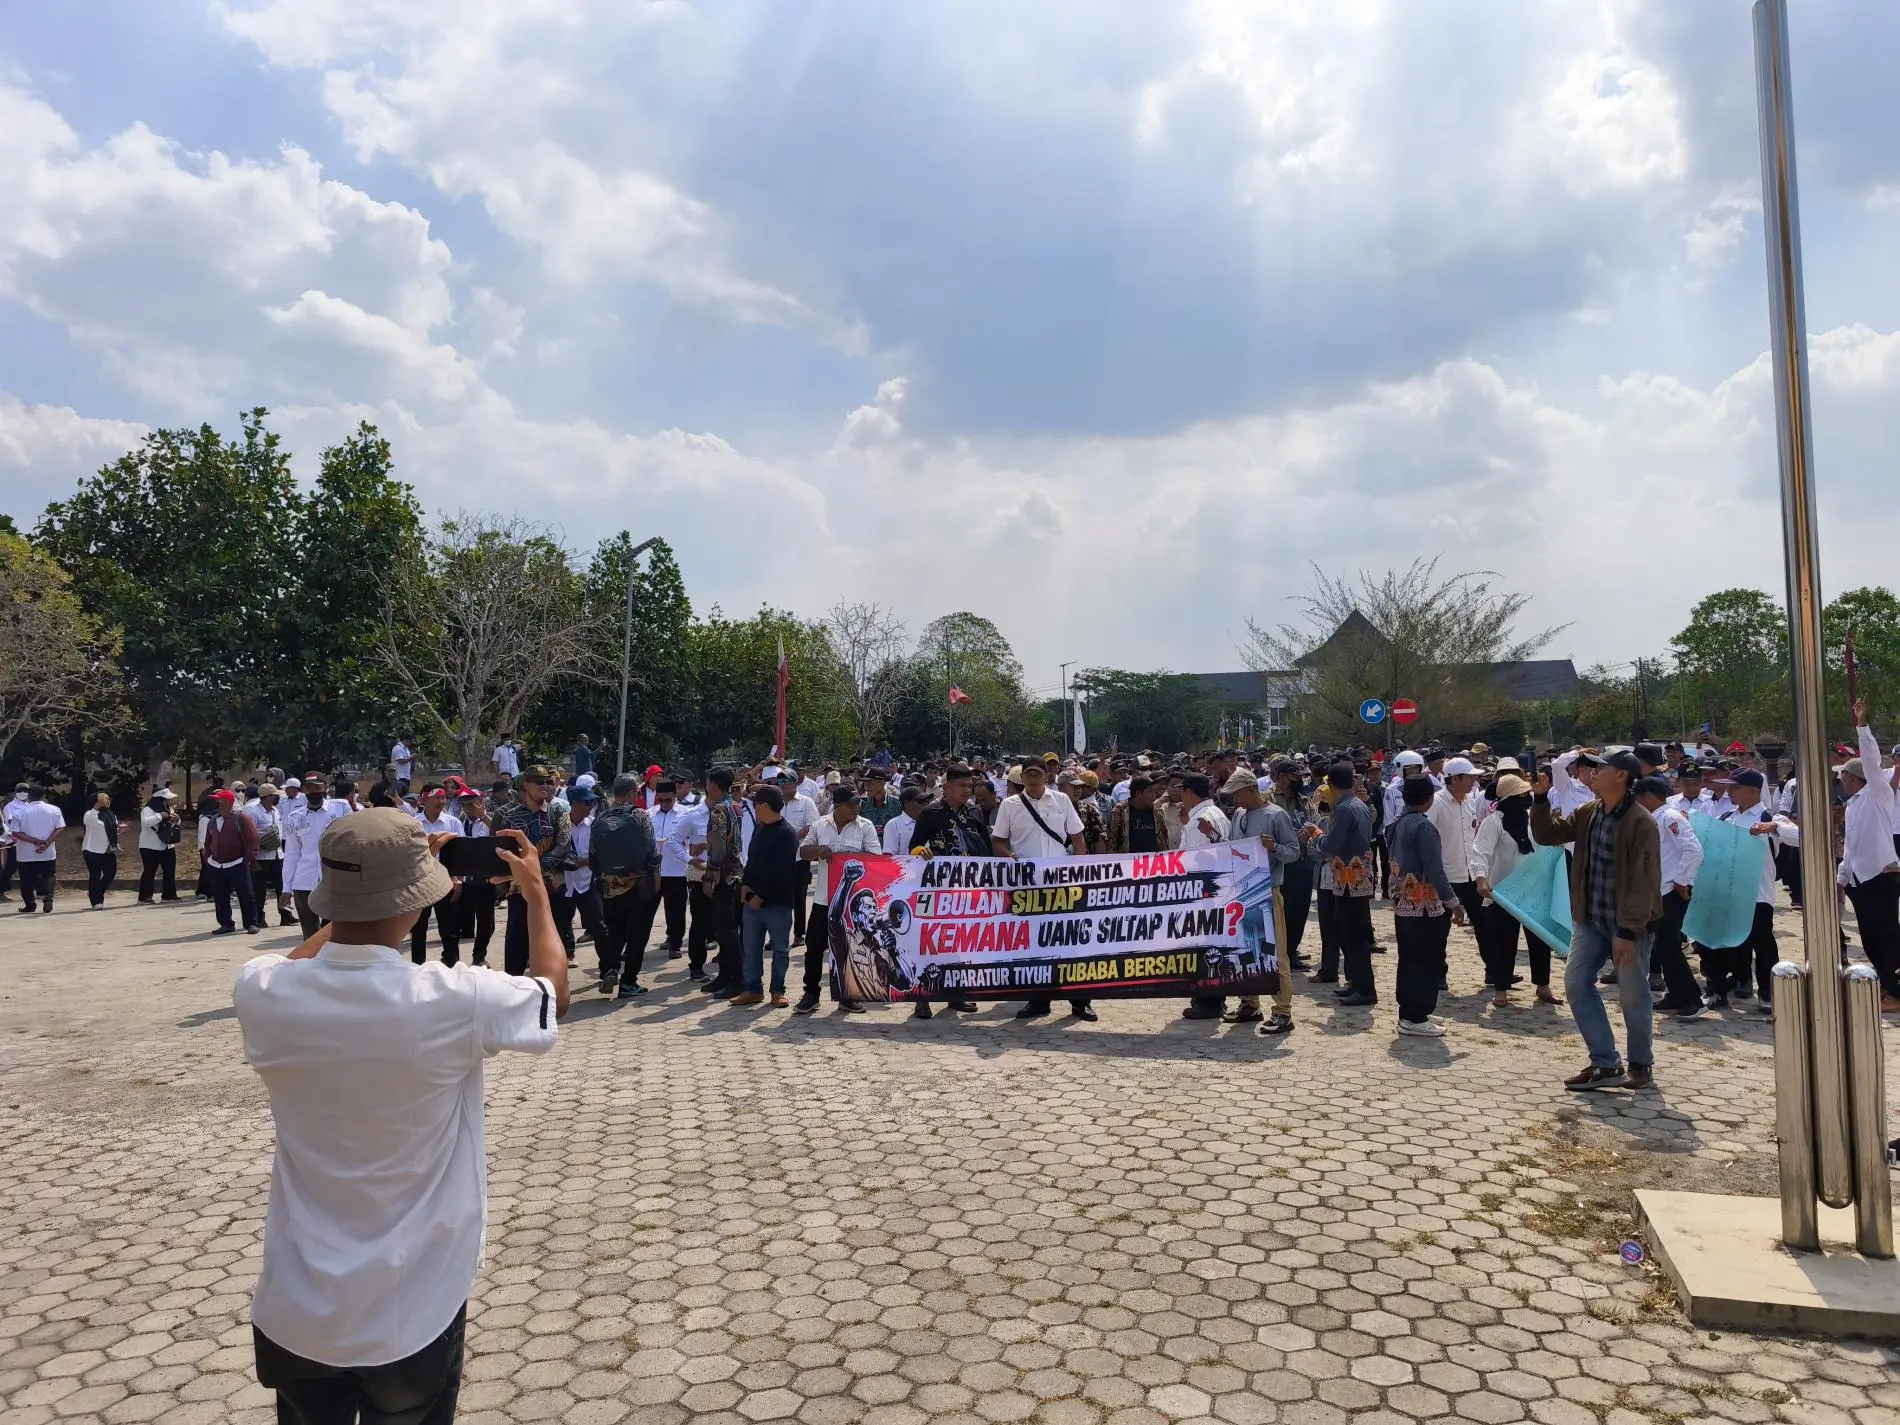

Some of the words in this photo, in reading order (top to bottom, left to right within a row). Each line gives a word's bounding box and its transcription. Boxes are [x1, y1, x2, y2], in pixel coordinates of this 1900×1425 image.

[921, 859, 1036, 888] APARATUR
[1043, 863, 1123, 885] MEMINTA
[1132, 851, 1185, 879] HAK
[916, 894, 933, 916] 4
[936, 891, 1006, 916] BULAN
[1012, 887, 1082, 913] SILTAP
[1087, 889, 1136, 908] BELUM
[1138, 886, 1153, 904] DI
[920, 922, 1030, 955] KEMANA
[1038, 917, 1092, 947] UANG
[1097, 913, 1161, 944] SILTAP
[1167, 902, 1245, 939] KAMI?
[944, 967, 1010, 987] APARATUR
[1013, 965, 1052, 984] TIYUH
[1057, 960, 1117, 984] TUBABA
[1124, 953, 1197, 979] BERSATU
